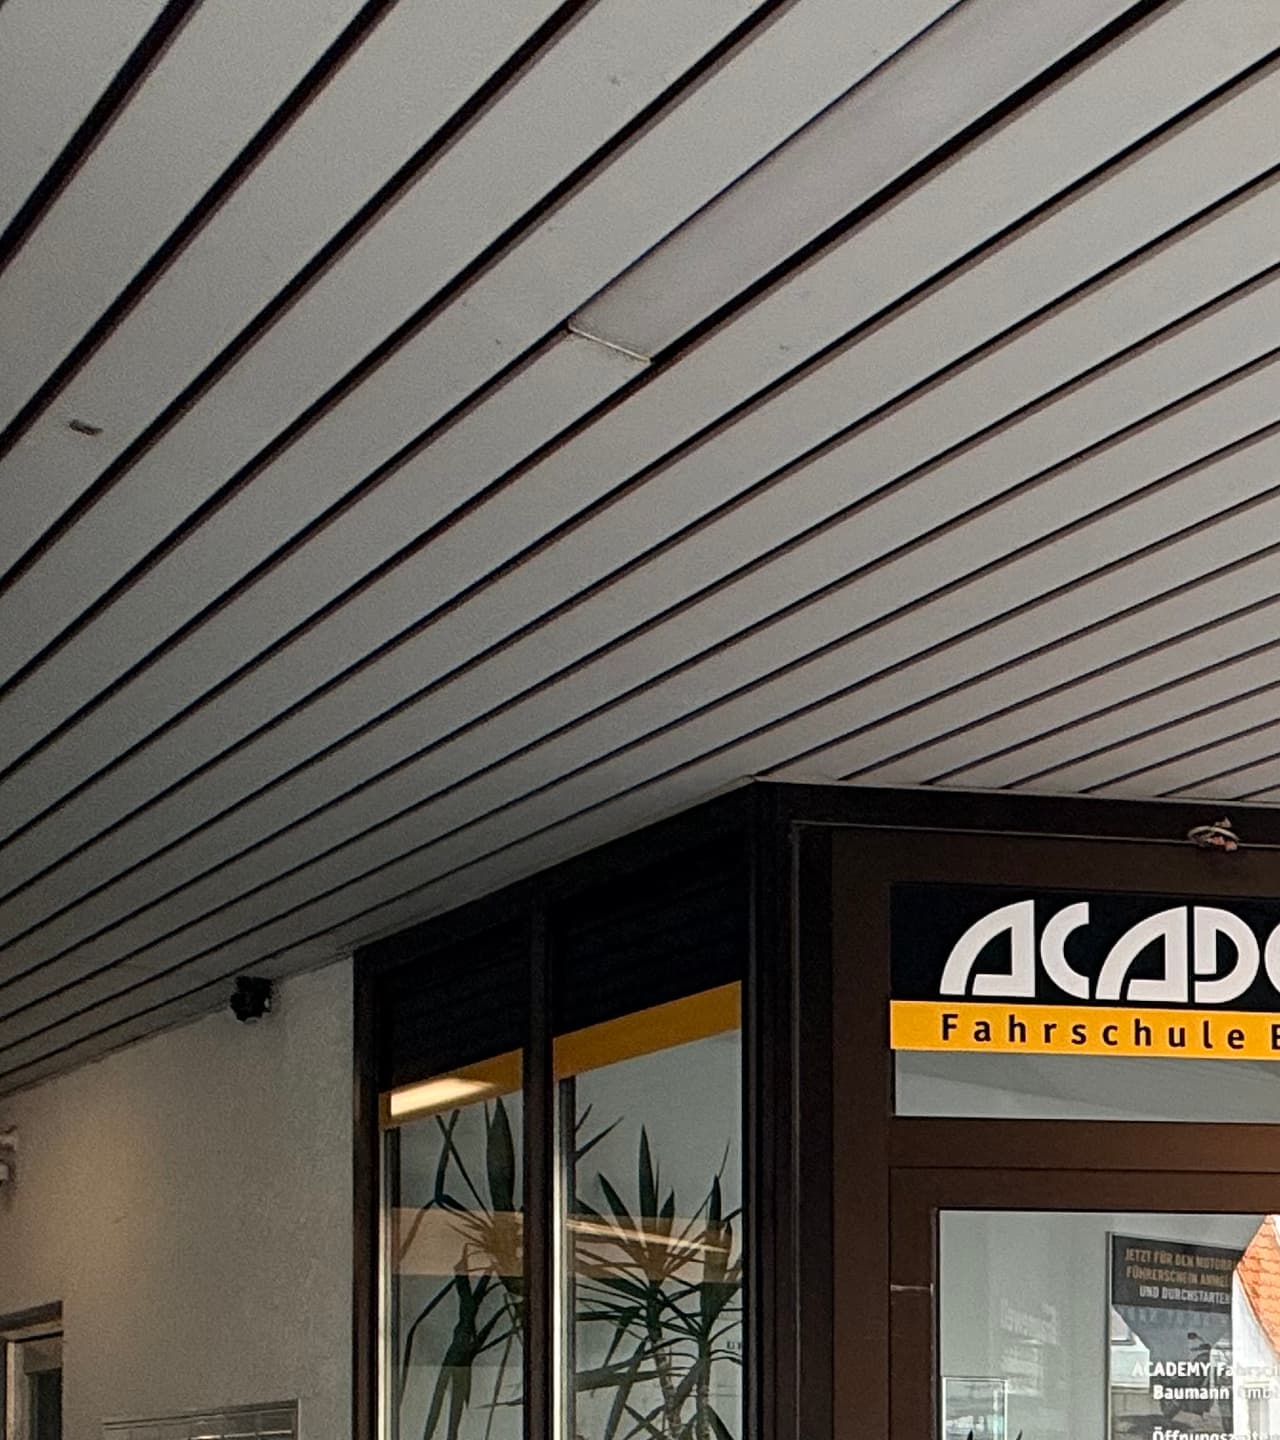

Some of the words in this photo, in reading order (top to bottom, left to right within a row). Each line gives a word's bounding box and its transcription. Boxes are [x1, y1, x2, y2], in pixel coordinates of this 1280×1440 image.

[941, 1013, 1245, 1051] Fahrschule
[1131, 1361, 1212, 1377] ACADEMY
[1153, 1384, 1230, 1400] Baumann
